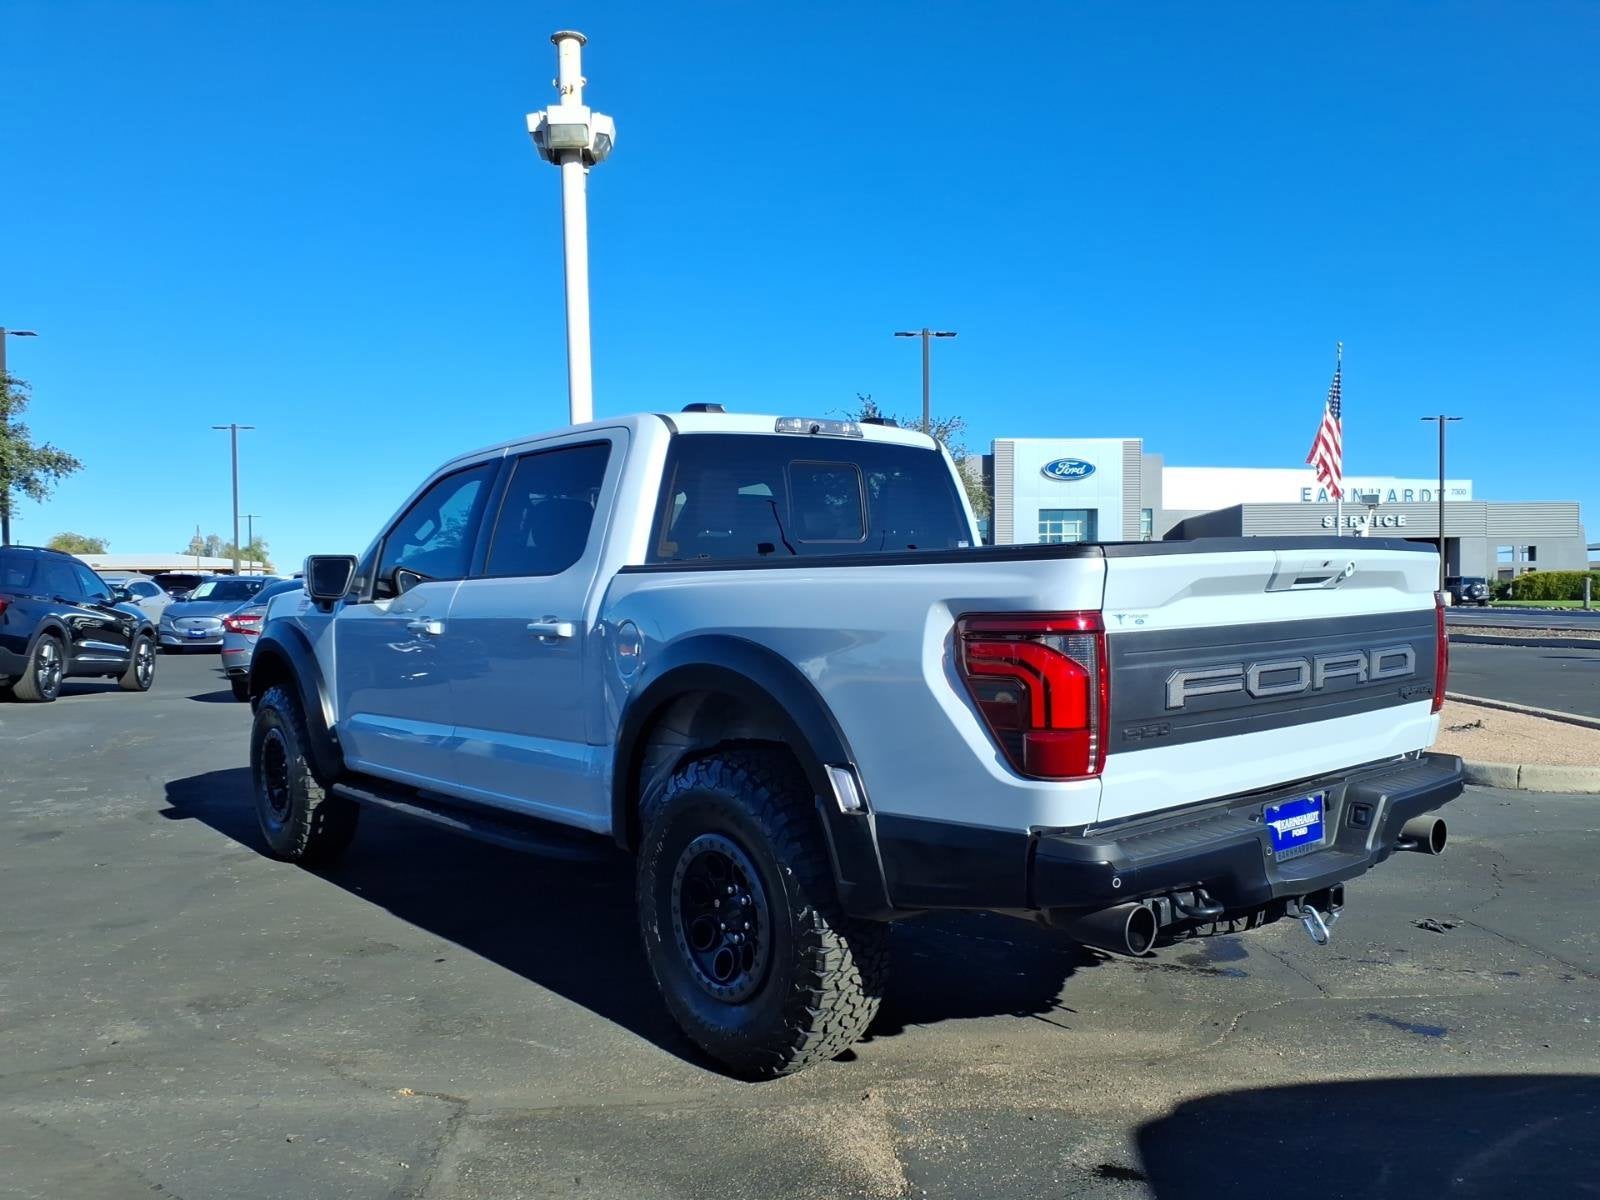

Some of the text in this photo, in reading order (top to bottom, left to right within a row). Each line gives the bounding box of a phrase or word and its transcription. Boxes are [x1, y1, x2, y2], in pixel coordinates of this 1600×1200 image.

[1055, 461, 1087, 475] Ford
[1322, 515, 1407, 528] SERVICE
[1165, 643, 1416, 710] FORD
[1291, 826, 1308, 838] FORD
